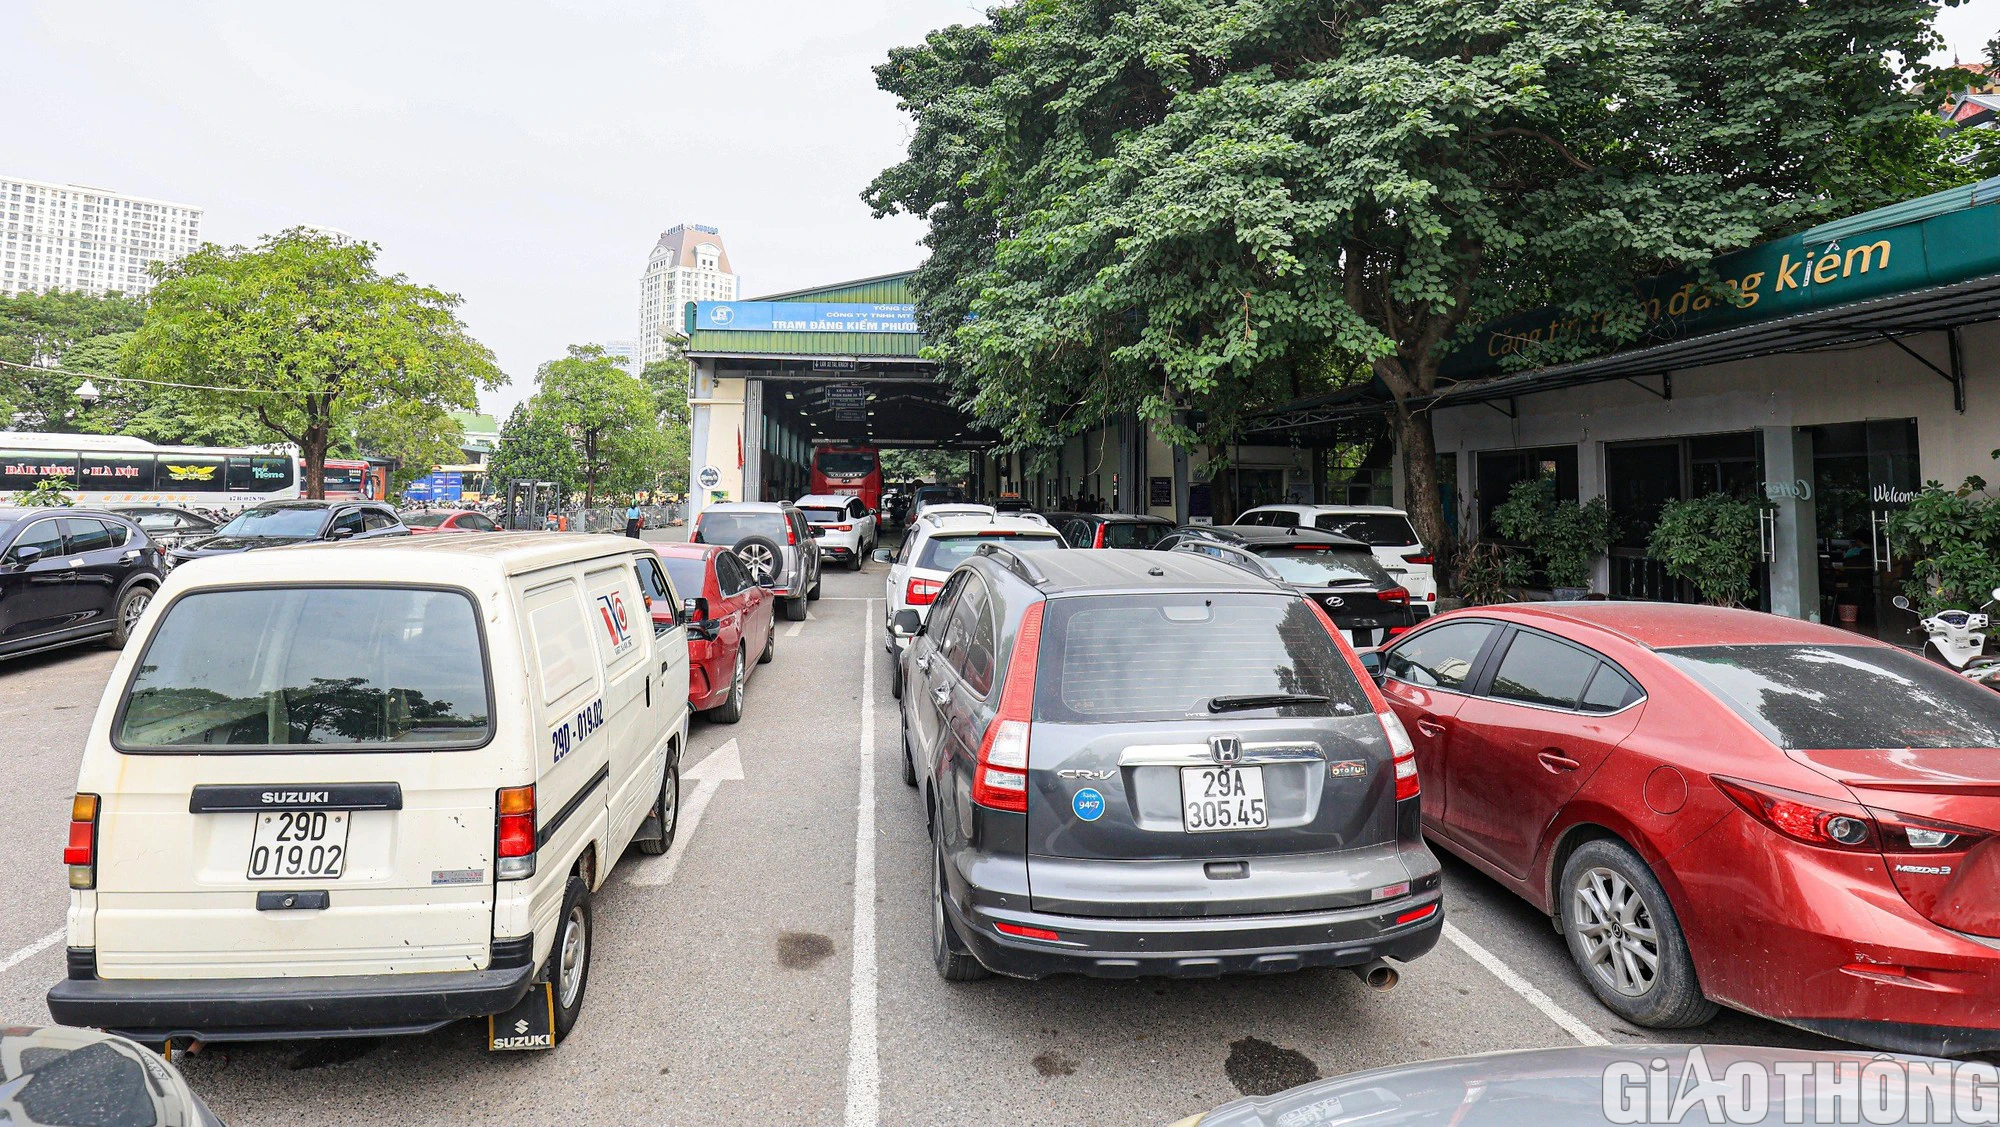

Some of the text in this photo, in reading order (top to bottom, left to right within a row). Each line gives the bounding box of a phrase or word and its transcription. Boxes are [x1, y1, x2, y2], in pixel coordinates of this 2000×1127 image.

[772, 321, 806, 330] TRẠM
[810, 319, 843, 330] ĐĂNG
[847, 318, 878, 331] KIỂM
[40, 464, 75, 475] NÔNG
[91, 465, 139, 478] HÀ NỘI
[255, 469, 285, 479] Home
[552, 722, 571, 764] 29D
[577, 698, 604, 742] 019.02
[1056, 769, 1117, 780] CR-V
[1202, 770, 1246, 797] 29A
[261, 791, 329, 803] SUZUKI
[1188, 798, 1265, 828] 305.45
[276, 812, 327, 842] 29D
[252, 845, 342, 875] 019.02
[493, 1034, 551, 1049] SUZUKI
